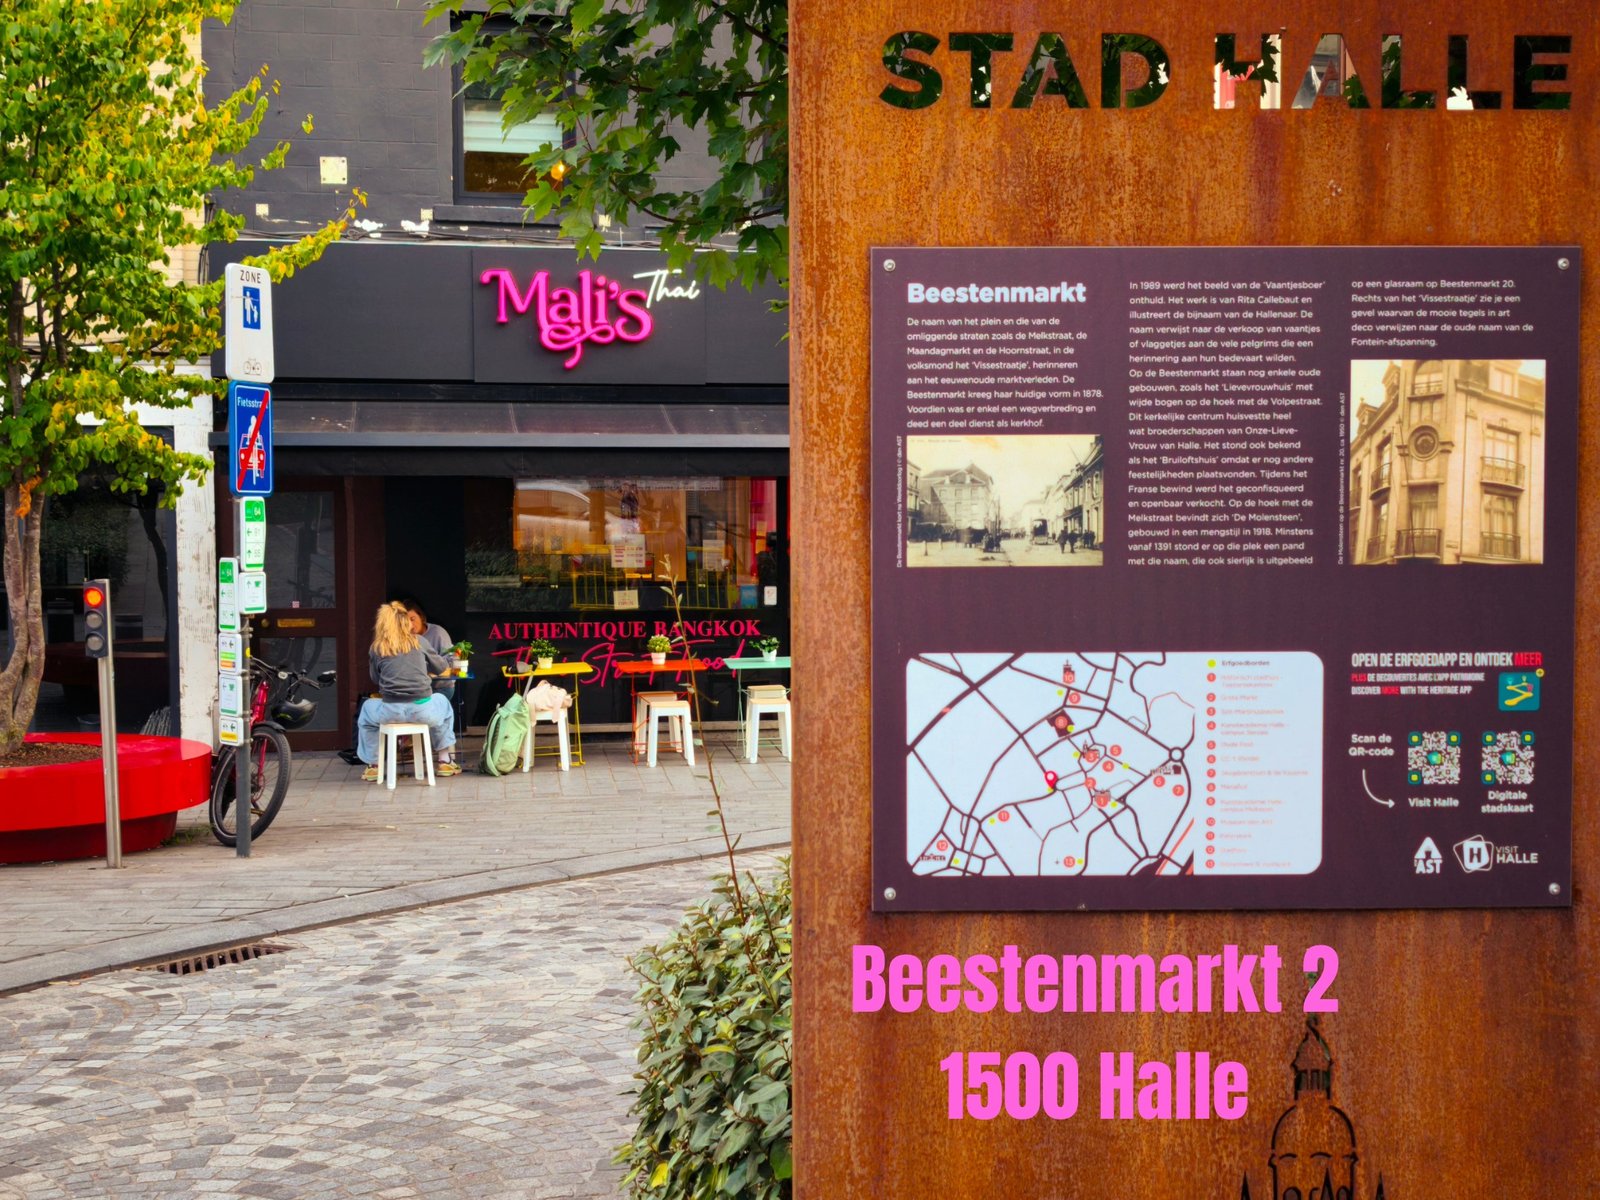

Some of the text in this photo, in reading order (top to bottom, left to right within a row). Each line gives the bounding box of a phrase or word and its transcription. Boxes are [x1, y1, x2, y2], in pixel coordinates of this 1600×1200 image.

[878, 31, 1572, 110] STAD HALLE
[240, 270, 262, 284] ZONE
[632, 268, 701, 309] Thai
[1140, 281, 1161, 289] 1989
[1187, 281, 1202, 289] het
[1204, 281, 1229, 289] beeld
[907, 281, 1087, 303] Beestenmarkt
[1351, 309, 1375, 318] gevel
[1459, 309, 1485, 318] tegels
[907, 332, 958, 342] omliggende
[992, 332, 1013, 340] zoals
[907, 347, 971, 356] Maandagmarkt
[1129, 355, 1179, 363] herinnering
[1219, 354, 1263, 362] bedevaart
[907, 361, 953, 370] volksmond
[956, 361, 969, 369] het
[1033, 361, 1078, 369] herinneren
[925, 376, 938, 384] het
[941, 376, 995, 384] eeuwenoude
[1296, 383, 1313, 391] met
[907, 391, 965, 399] Beestenmarkt
[968, 391, 992, 399] kreeg
[994, 390, 1013, 398] haar
[1015, 390, 1046, 399] huidige
[907, 405, 945, 413] Voordien
[977, 405, 999, 413] enkel
[1020, 404, 1083, 414] wegverbreding
[1129, 413, 1142, 421] Dit
[1144, 413, 1185, 422] kerkelijke
[1226, 412, 1271, 420] huisvestte
[1273, 412, 1291, 420] heel
[907, 420, 928, 428] deed
[1147, 427, 1224, 435] broederschappen
[1129, 470, 1194, 479] feestelijkheden
[1260, 470, 1291, 479] Tijdens
[1293, 470, 1307, 478] het
[1128, 485, 1158, 493] Franse
[1160, 485, 1192, 493] bewind
[1236, 484, 1304, 494] geconfisqueerd
[1128, 514, 1173, 522] Melkstraat
[488, 619, 761, 640] AUTHENTIQUE BANGKOK
[1352, 652, 1543, 667] OPEN DE ERFGOEDAPP EN ONTDEK MEER
[1400, 686, 1416, 694] WITH
[1417, 686, 1428, 694] THE
[1430, 686, 1458, 694] HERITAGE
[1460, 686, 1472, 694] APP
[1352, 734, 1392, 743] Scan de
[1349, 747, 1394, 756] QR-code
[1488, 791, 1527, 801] Digitale
[1408, 797, 1459, 807] Visit Halle
[1481, 803, 1533, 813] stadskaart
[1496, 853, 1539, 864] HALLE
